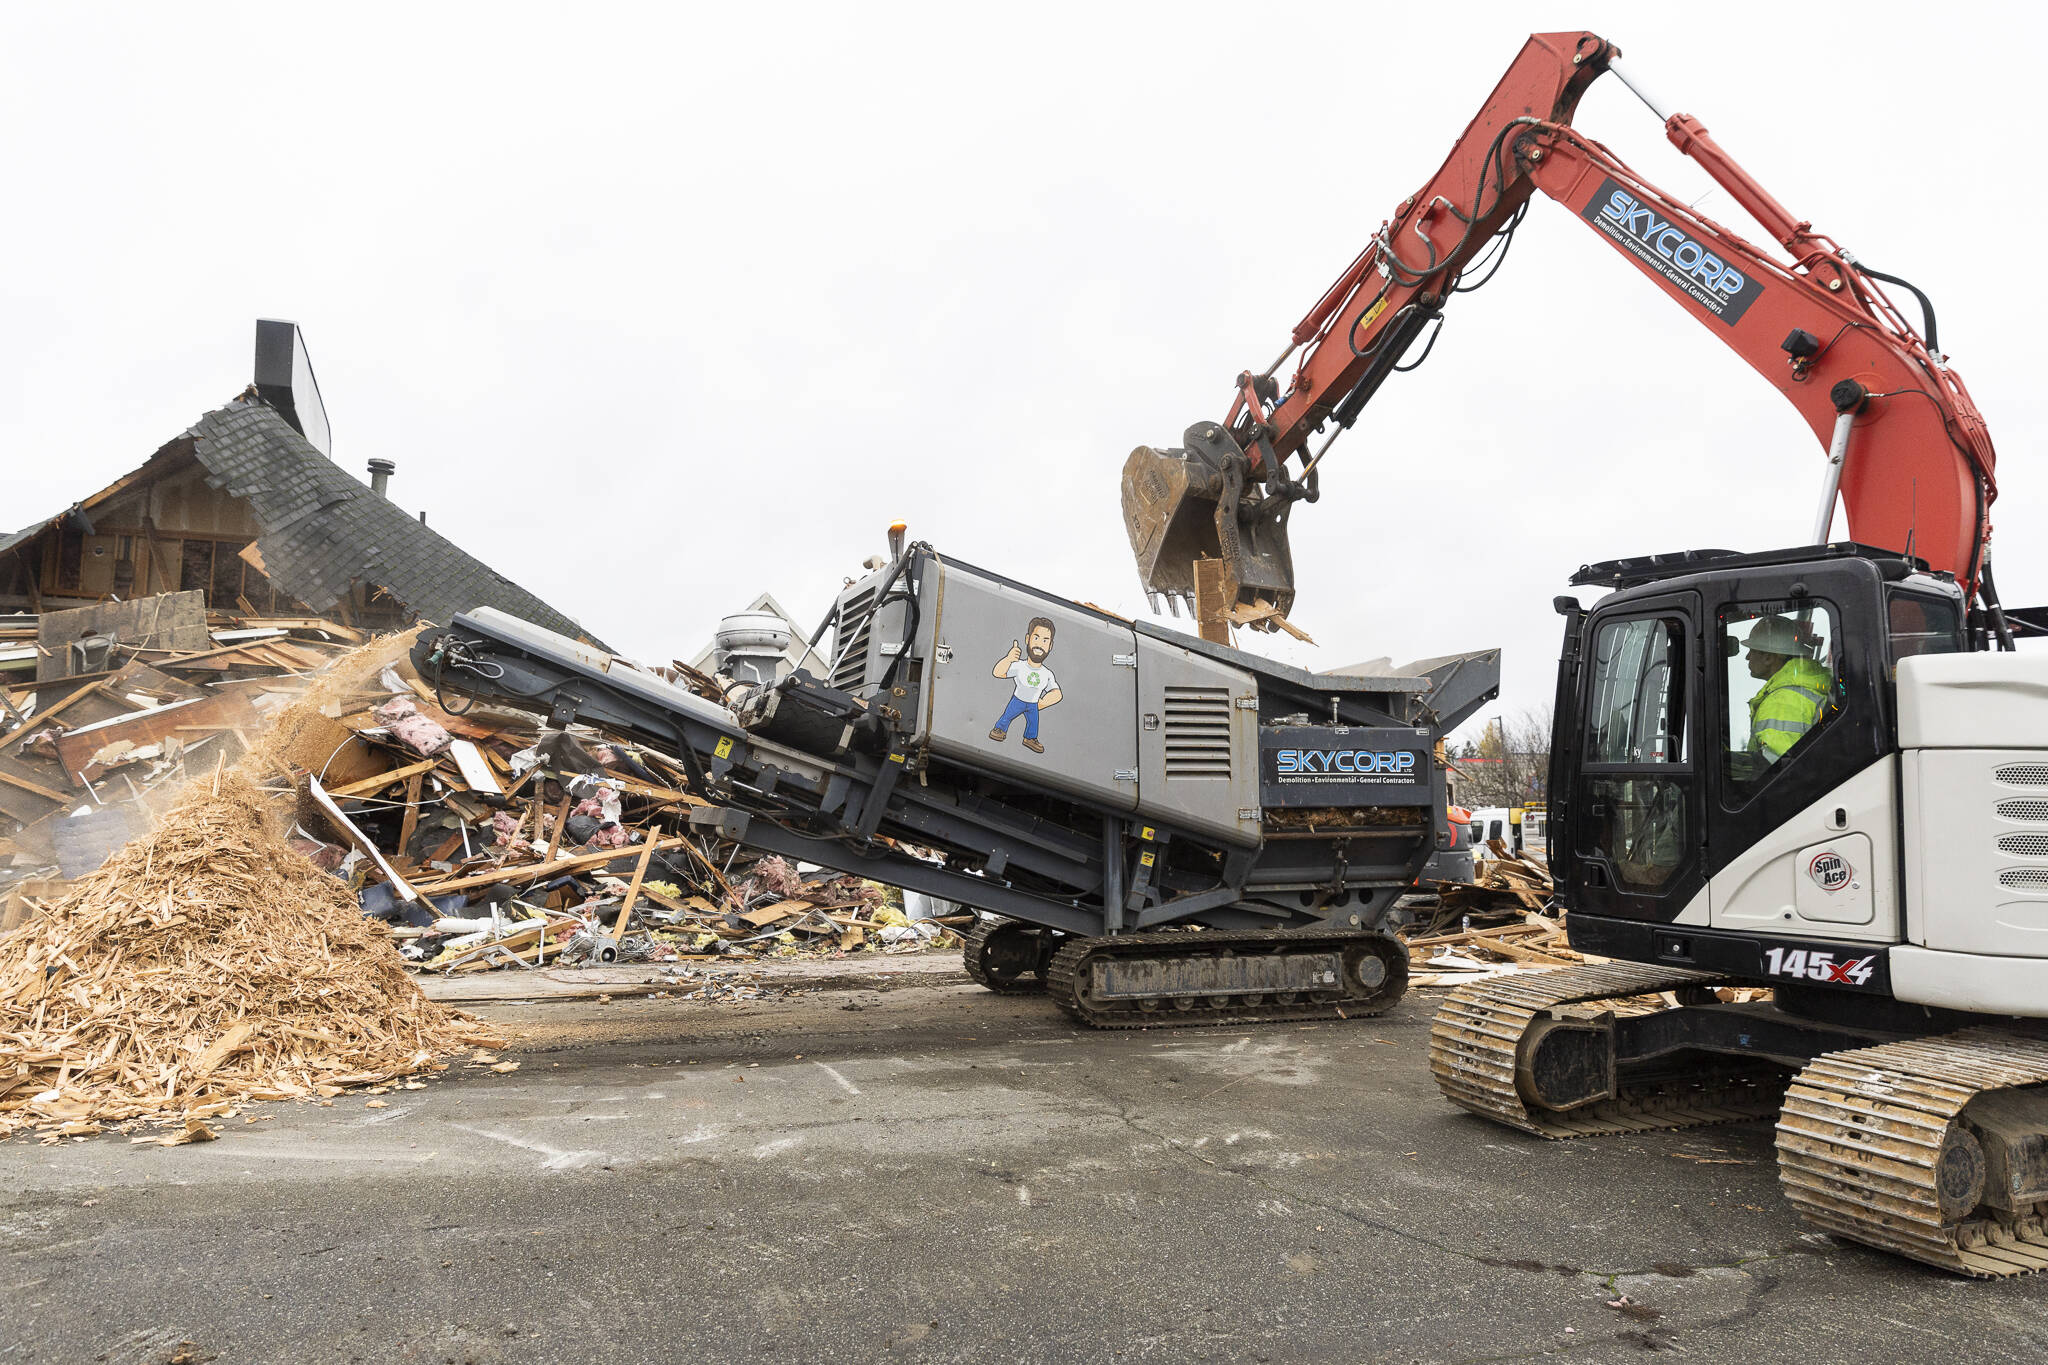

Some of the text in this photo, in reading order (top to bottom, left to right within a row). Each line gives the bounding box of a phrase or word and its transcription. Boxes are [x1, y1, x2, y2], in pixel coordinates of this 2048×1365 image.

[1601, 190, 1744, 295] SKYCORP
[1593, 215, 1723, 315] Demolition Environmental General Contractors
[1718, 291, 1730, 301] LTD
[1277, 750, 1415, 773] SKYCORP
[1278, 776, 1415, 785] Demolition Environmental General Contractors
[1815, 857, 1841, 874] Spin
[1824, 870, 1847, 885] Ace
